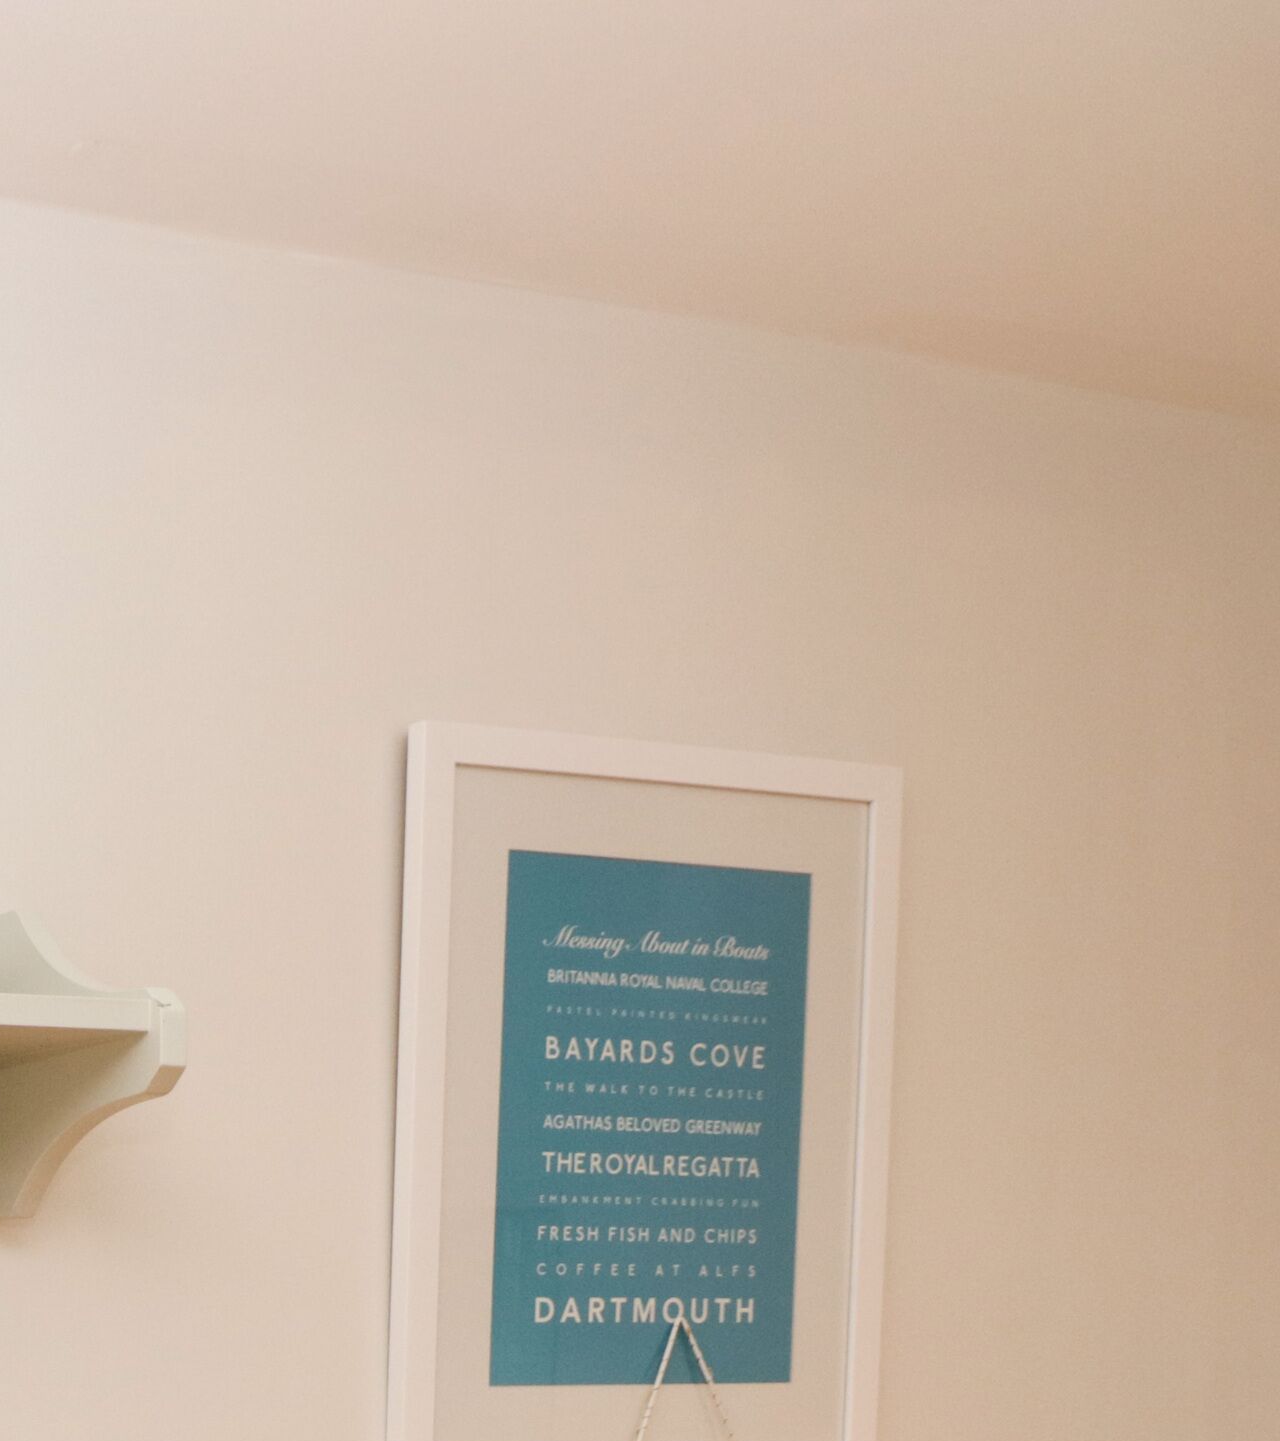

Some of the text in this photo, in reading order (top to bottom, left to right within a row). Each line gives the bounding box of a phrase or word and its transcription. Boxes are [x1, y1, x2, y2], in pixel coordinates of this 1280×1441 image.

[542, 924, 770, 960] Messing About in Boats
[547, 968, 768, 996] BRITANNIA ROYAL NAVAL COLLEGE
[546, 1005, 601, 1017] PASTEL
[611, 1007, 676, 1021] PAINTED
[544, 1035, 766, 1070] BAYARDS COVE
[544, 1081, 765, 1101] THE WALK TO THE CASTLE
[543, 1114, 762, 1137] AGATHAS BELOVED GREENWAY
[542, 1151, 760, 1179] THE ROYAL REGATTA
[538, 1194, 760, 1208] EMBANKMENT CRABBING FUN
[537, 1225, 758, 1244] FRESH FISH AND CHIPS
[536, 1262, 757, 1278] COFFEE AT ALFS
[533, 1296, 755, 1324] DARTMOUTH
